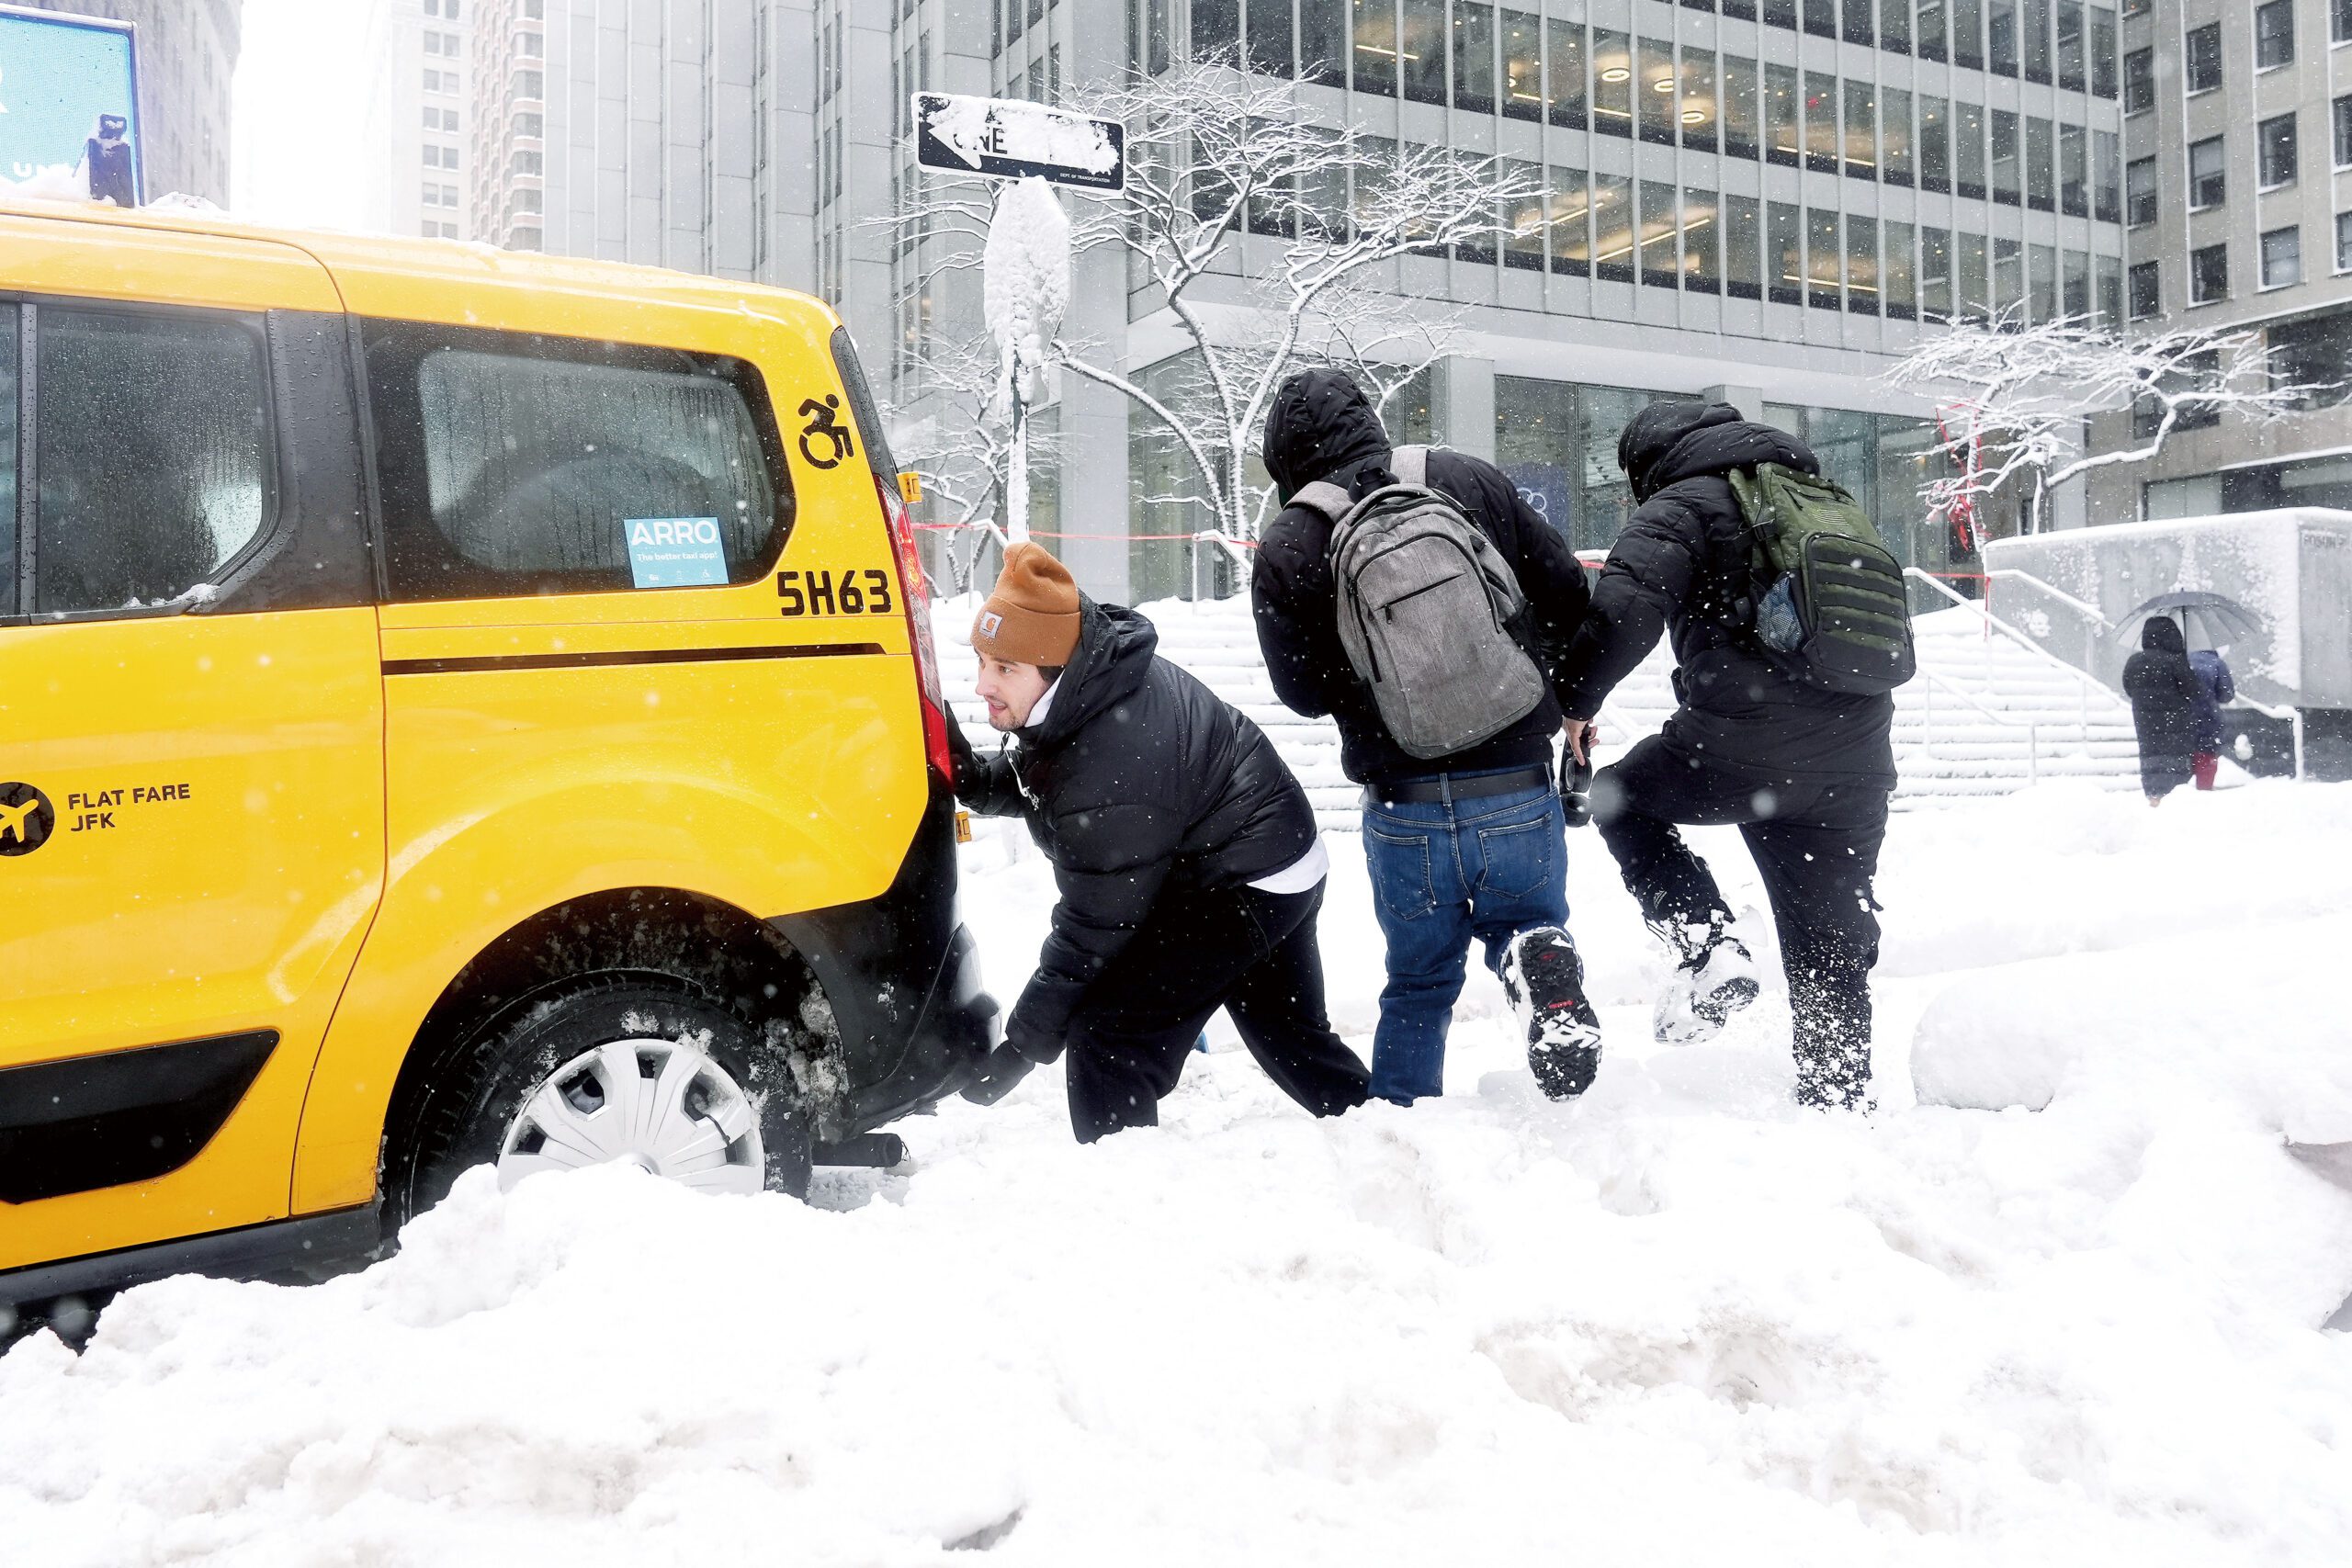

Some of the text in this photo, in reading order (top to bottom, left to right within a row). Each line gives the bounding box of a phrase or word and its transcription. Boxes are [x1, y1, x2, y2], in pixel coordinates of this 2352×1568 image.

[1077, 175, 1111, 183] TRANSPORTATION
[631, 520, 717, 546] ARRO
[637, 553, 653, 561] The
[654, 552, 680, 560] better
[777, 570, 892, 616] 5H63
[68, 784, 191, 810] FLAT FARE
[71, 812, 116, 832] JFK
